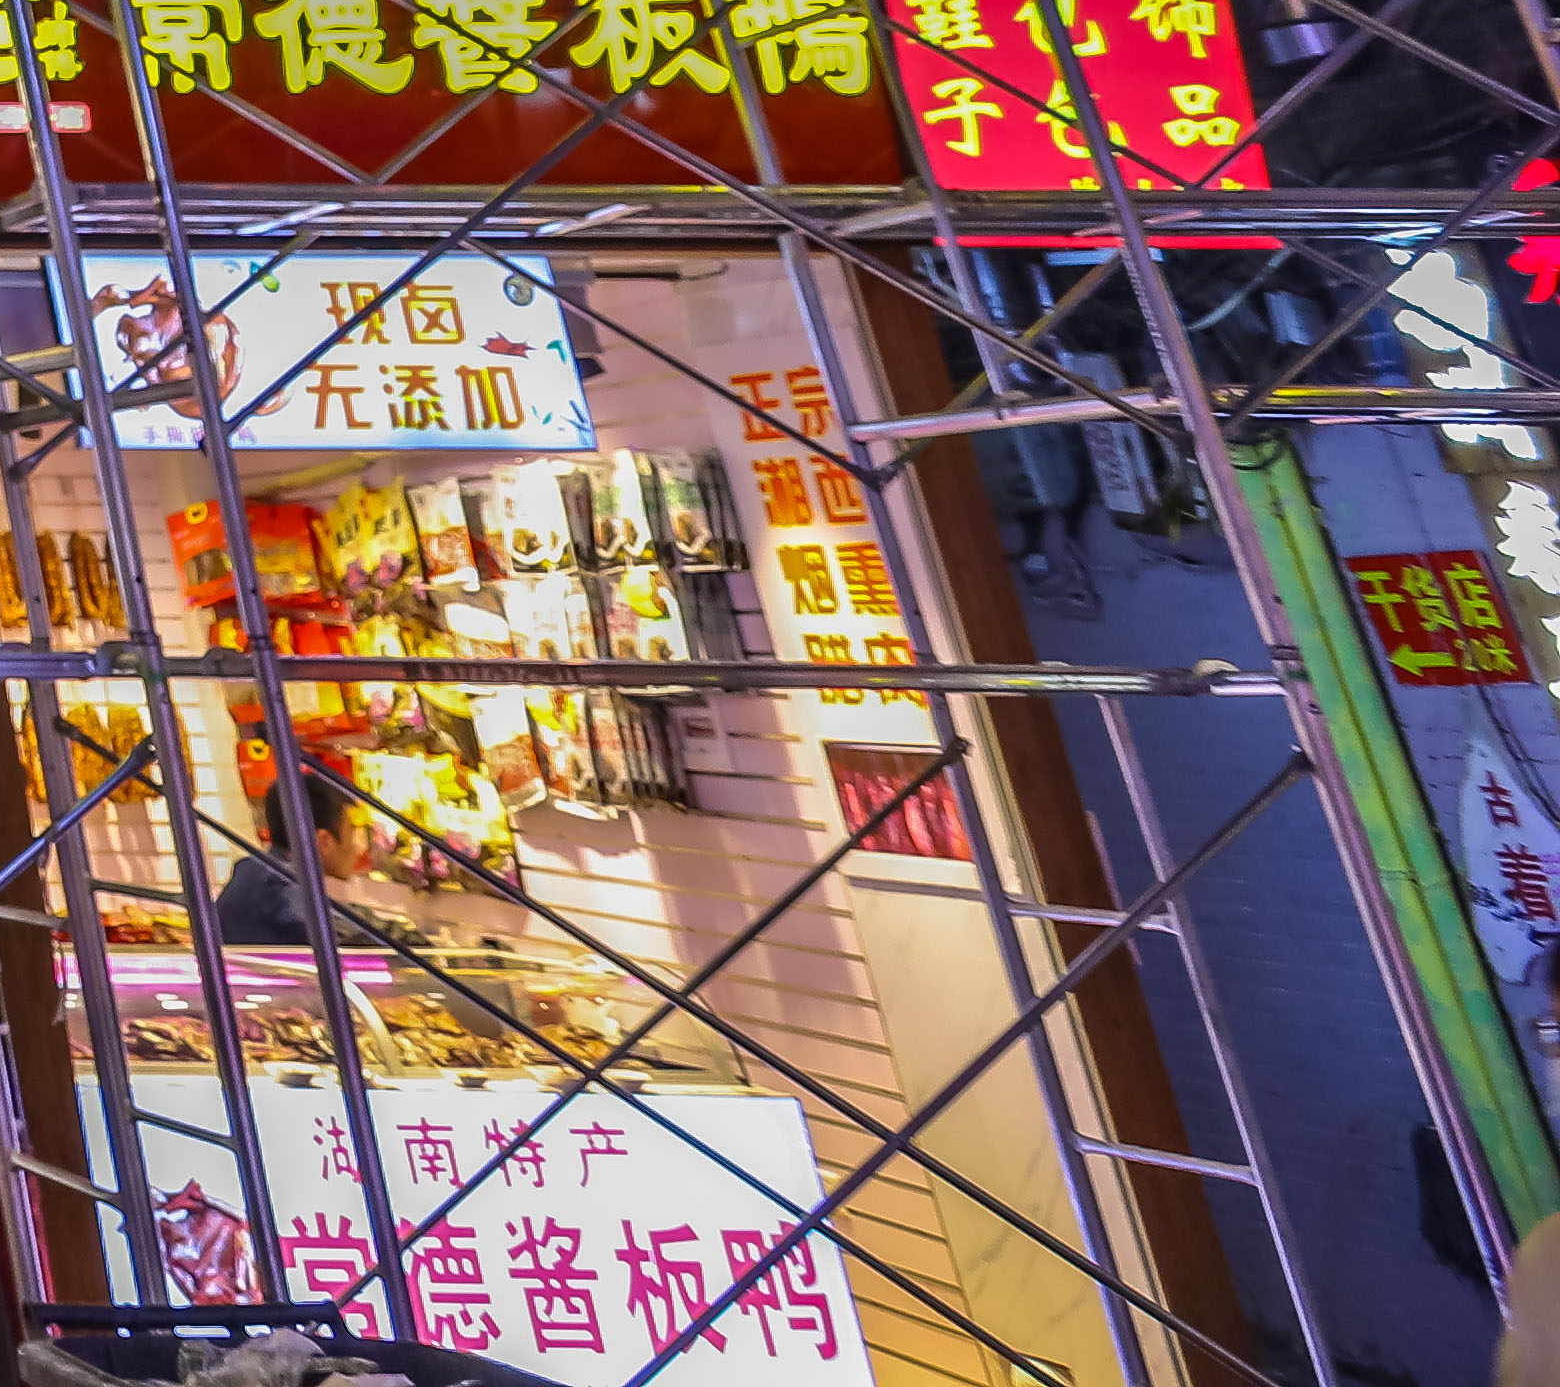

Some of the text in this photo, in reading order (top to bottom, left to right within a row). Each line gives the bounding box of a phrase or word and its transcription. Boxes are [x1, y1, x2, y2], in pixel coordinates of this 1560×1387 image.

[321, 279, 467, 348] 现卤
[304, 360, 532, 435] 无添加
[1354, 560, 1505, 633] 干货店
[312, 1115, 630, 1191] 湖南特产
